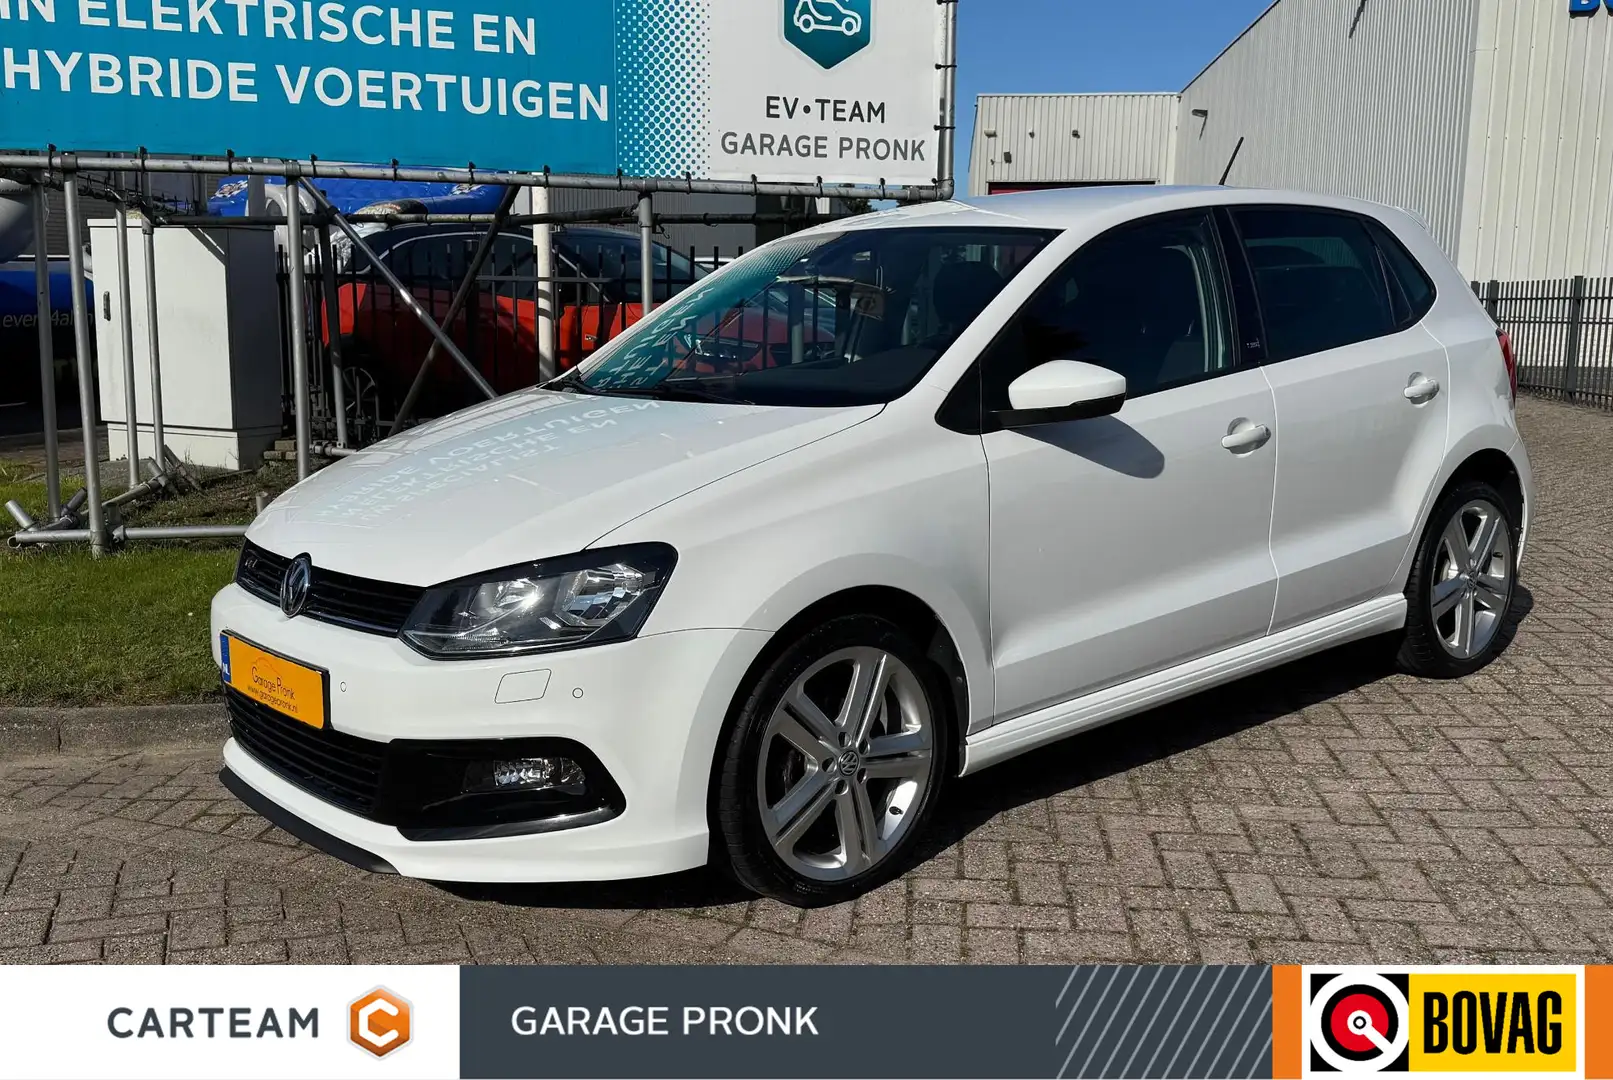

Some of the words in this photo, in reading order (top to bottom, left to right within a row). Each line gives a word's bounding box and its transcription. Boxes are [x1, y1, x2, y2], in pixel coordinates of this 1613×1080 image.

[79, 0, 455, 50] ELEKTRISCHE
[473, 14, 536, 56] EN
[4, 48, 258, 103] HYBRIDE
[275, 64, 608, 122] VOERTUIGEN
[721, 132, 828, 158] GARAGE
[839, 137, 925, 161] PRONK
[251, 665, 277, 694] Garage
[276, 676, 296, 701] Pronk
